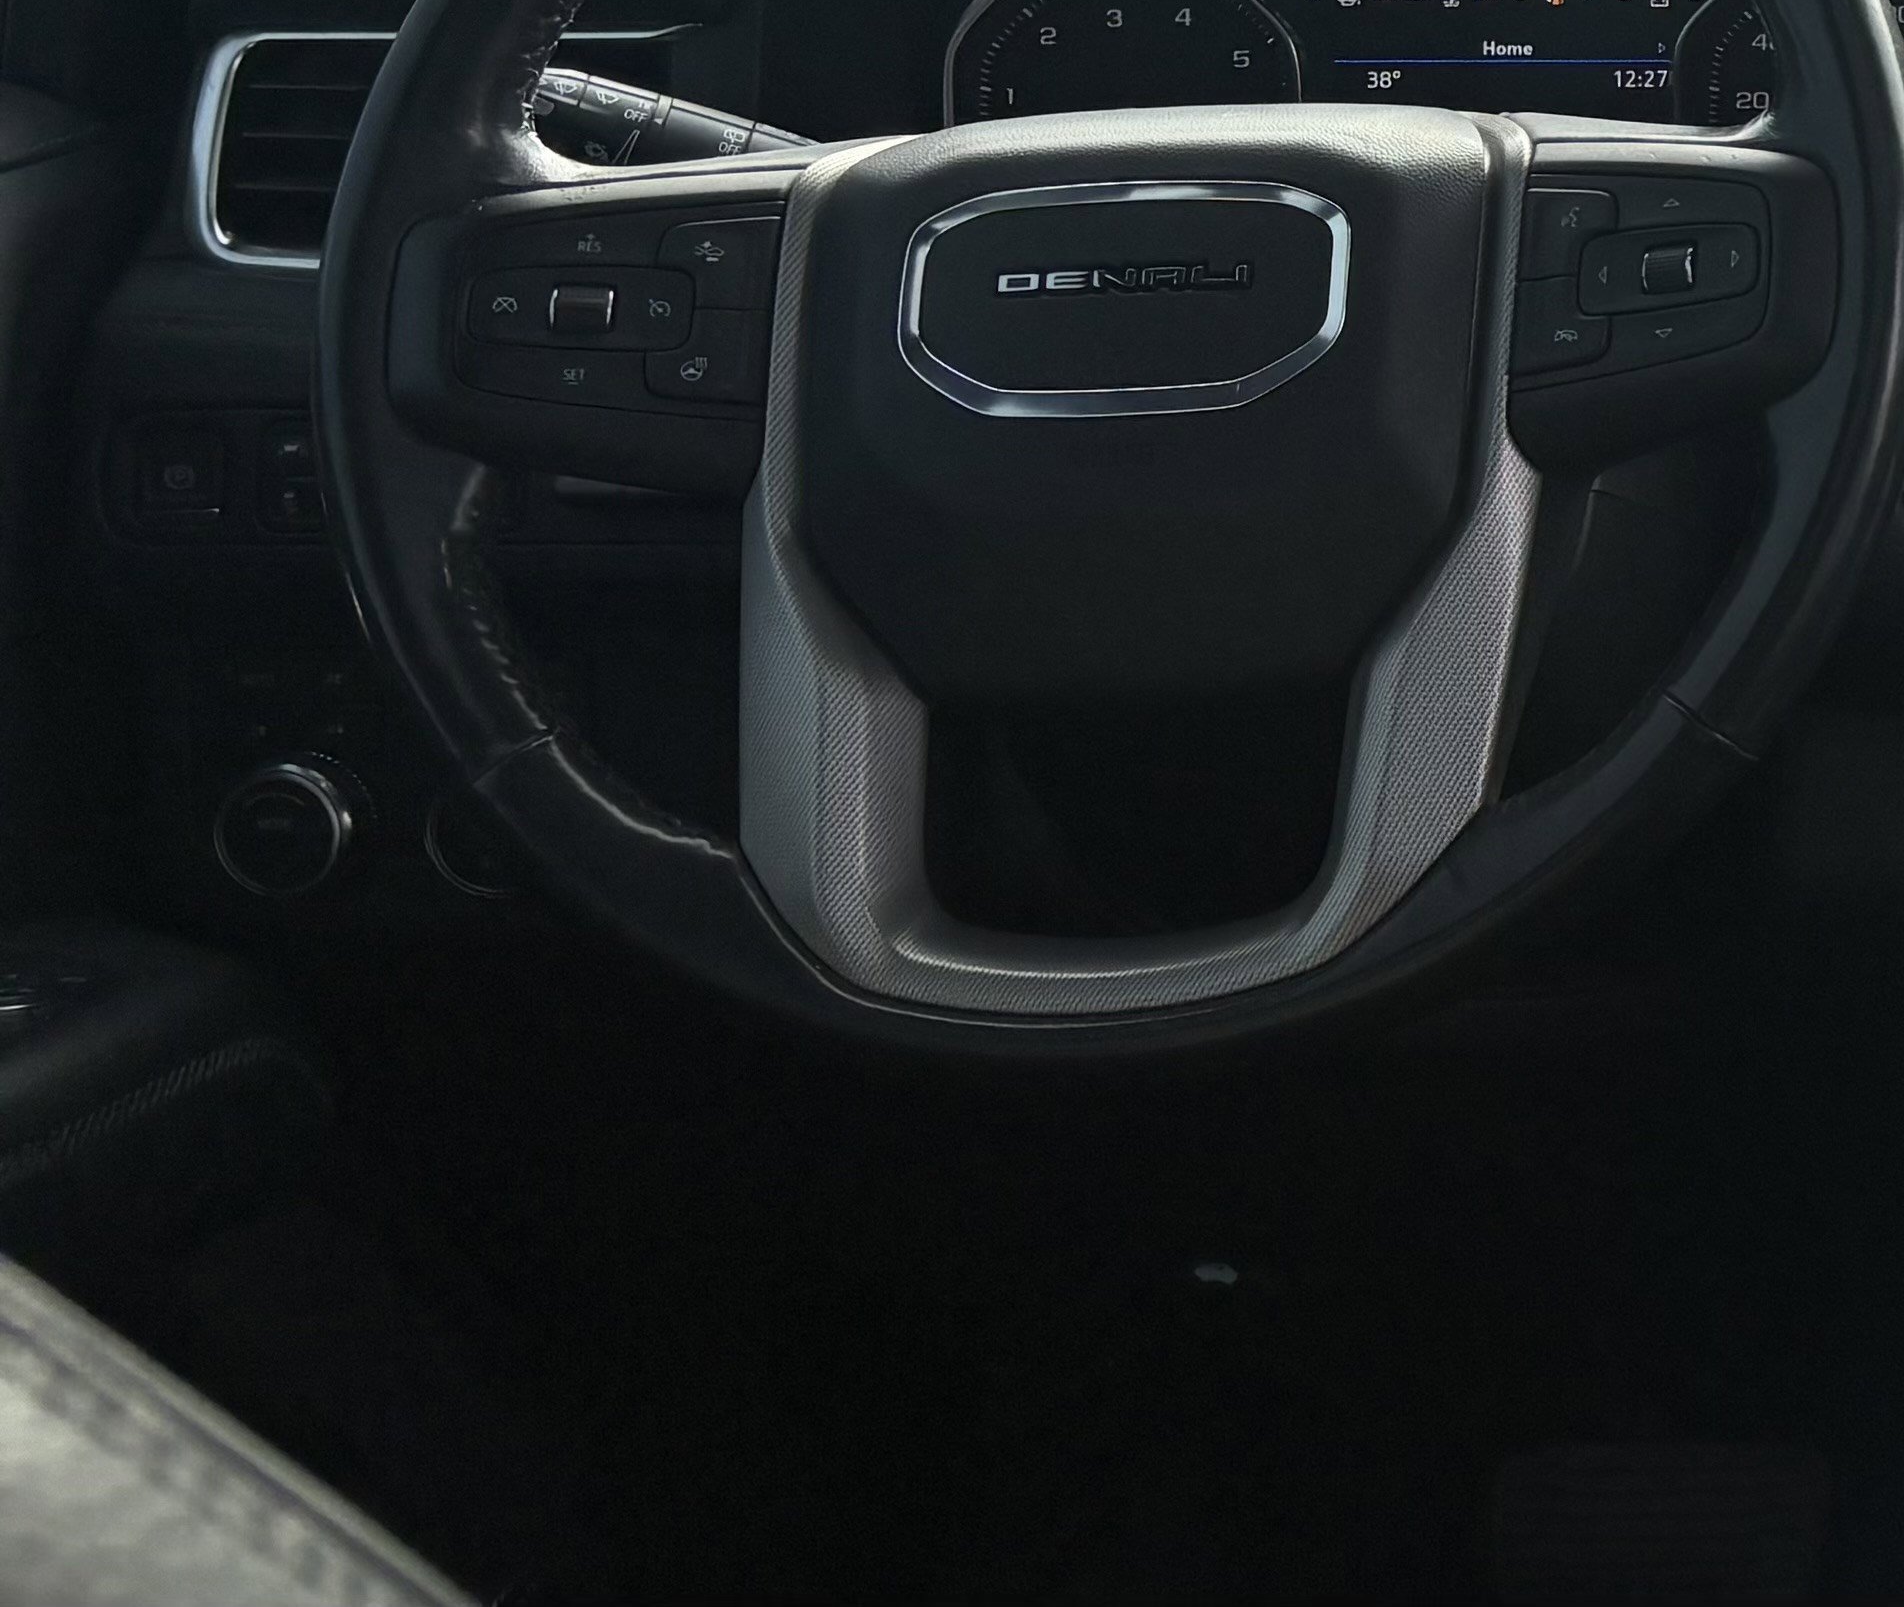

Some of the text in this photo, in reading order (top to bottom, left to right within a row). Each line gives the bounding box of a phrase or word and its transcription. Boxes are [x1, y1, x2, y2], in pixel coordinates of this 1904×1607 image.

[1106, 9, 1123, 28] 3
[1174, 8, 1192, 26] 4
[1040, 26, 1057, 45] 2
[1752, 32, 1776, 51] 4
[1482, 41, 1534, 56] Home
[1233, 50, 1250, 68] 5
[1367, 71, 1401, 90] 38°
[1614, 70, 1669, 90] 12:27
[1006, 87, 1014, 105] 1
[1736, 91, 1770, 110] 20
[623, 109, 648, 124] OFF
[577, 240, 602, 253] RES
[997, 264, 1248, 293] DENALI
[562, 368, 585, 380] SET
